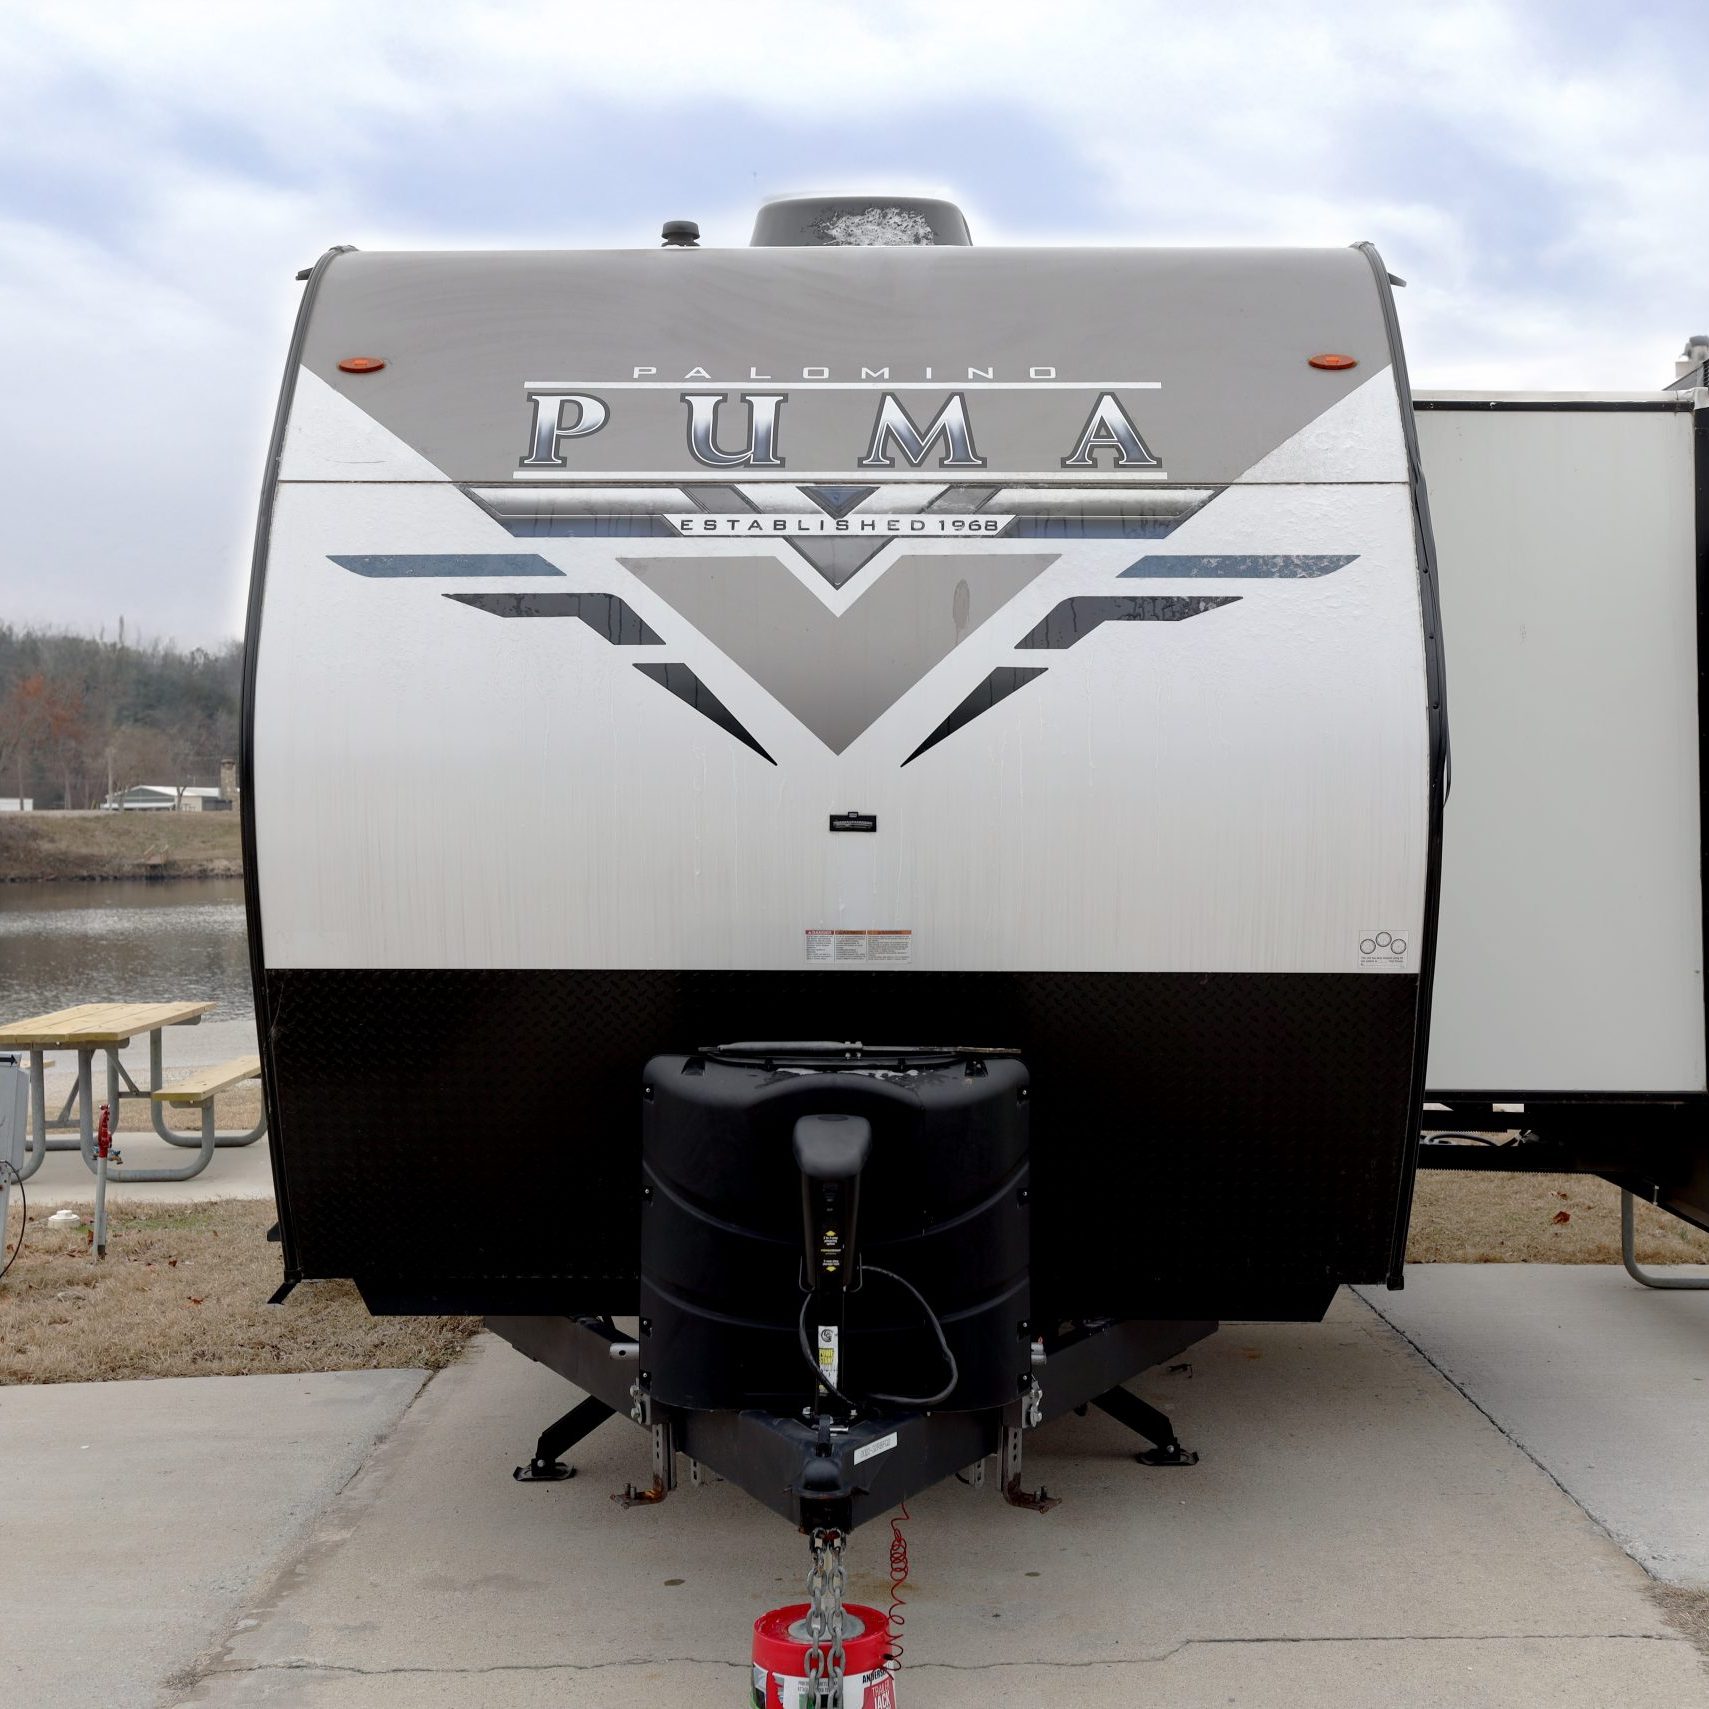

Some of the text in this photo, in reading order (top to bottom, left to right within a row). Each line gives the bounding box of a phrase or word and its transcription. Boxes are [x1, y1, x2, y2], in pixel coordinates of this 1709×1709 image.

[633, 366, 1057, 380] PALOMINO
[518, 391, 1162, 468] PUMA
[680, 519, 998, 532] ESTABLISHED 1968
